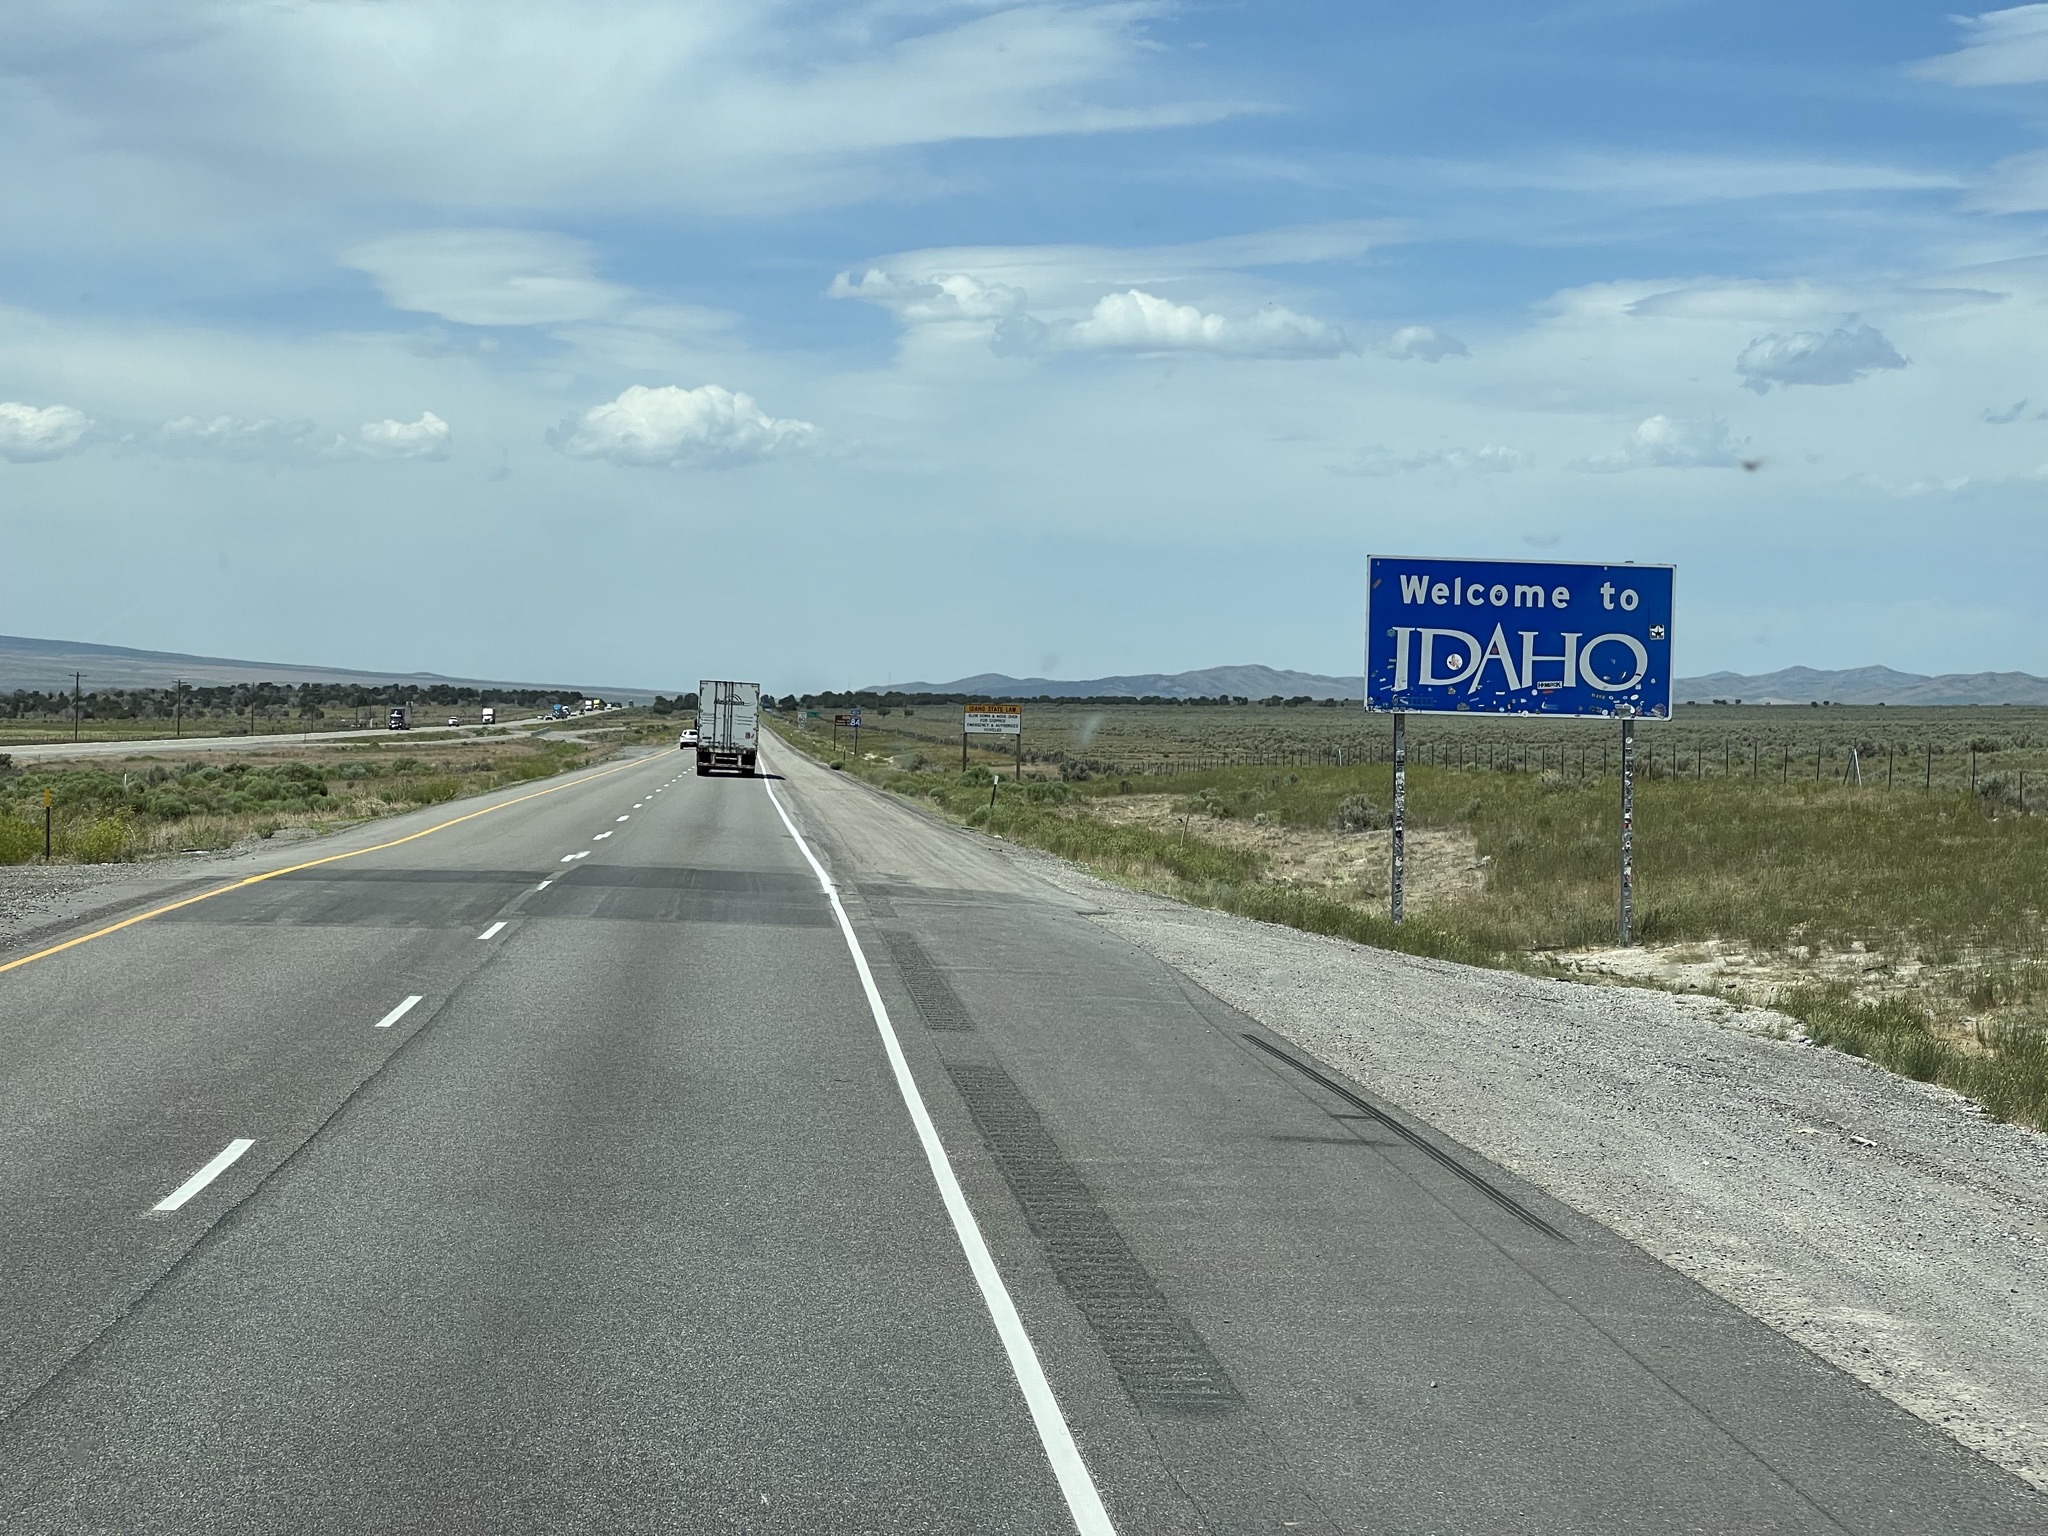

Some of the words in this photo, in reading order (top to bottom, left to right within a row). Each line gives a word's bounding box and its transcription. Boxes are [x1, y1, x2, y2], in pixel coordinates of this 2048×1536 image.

[1399, 574, 1570, 609] Welcome
[1600, 581, 1639, 611] to
[1391, 622, 1648, 695] IDAHO
[850, 718, 860, 726] 84
